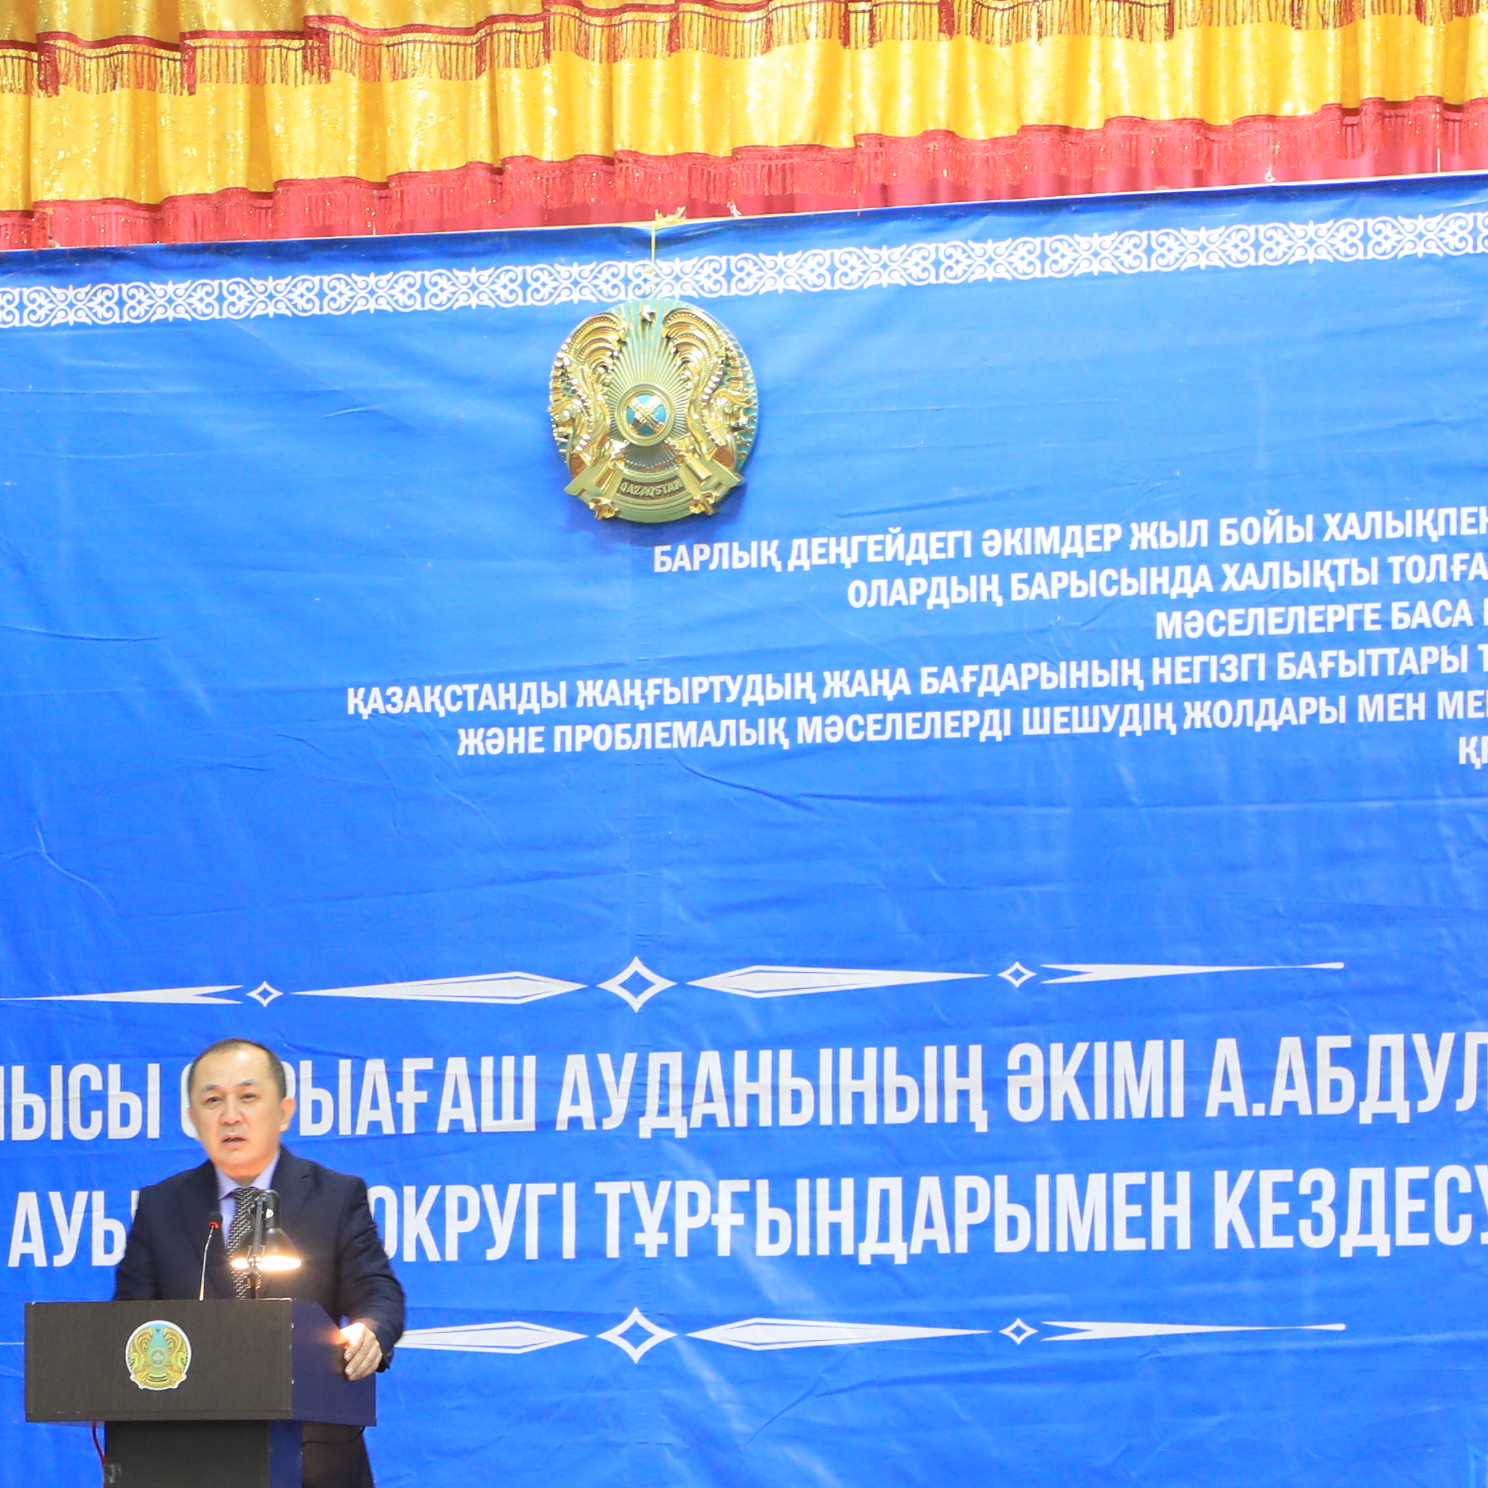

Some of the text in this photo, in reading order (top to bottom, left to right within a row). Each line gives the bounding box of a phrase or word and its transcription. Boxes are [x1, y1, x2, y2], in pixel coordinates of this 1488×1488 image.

[619, 480, 684, 497] QAZAQSTAN
[654, 541, 781, 573] БАРЛЫҚ
[788, 527, 972, 571] ДЕҢГЕЙДЕГІ
[981, 523, 1123, 558] ӘКІМДЕР
[1129, 519, 1209, 551] ЖЫЛ
[1219, 509, 1314, 547] БОЙЫ
[847, 574, 1004, 609] ОЛАРДЫҢ
[1010, 565, 1214, 601] БАРЫСЫНДА
[1220, 557, 1379, 592] ХАЛЫҚТЫ
[1155, 602, 1382, 640] МӘСЕЛЕЛЕРГЕ
[1390, 599, 1474, 630] БАСА
[347, 681, 567, 720] ҚАЗАҚСТАНДЫ
[576, 671, 816, 711] ЖАҢҒЫРТУДЫҢ
[821, 668, 912, 703] ЖАҢА
[920, 658, 1145, 698] БАҒДАРЫНЫҢ
[1152, 653, 1266, 685] НЕГІЗГІ
[1277, 645, 1469, 681] БАҒЫТТАРЫ
[457, 726, 546, 756] ЖӘНЕ
[553, 717, 790, 753] ПРОБЛЕМАЛЫҚ
[797, 709, 1011, 744] МӘСЕЛЕЛЕРДІ
[1022, 703, 1177, 738] ШЕШУДІҢ
[1183, 696, 1346, 733] ЖОЛДАРЫ
[1357, 693, 1426, 723] МЕН
[555, 1045, 988, 1139] АУДАНЫНЫҢ
[1007, 1040, 1185, 1123] ӘКІМІ
[367, 1183, 576, 1262] ОКРУГІ
[594, 1172, 1191, 1265] ТҰРҒЫНДАРЫМЕН
